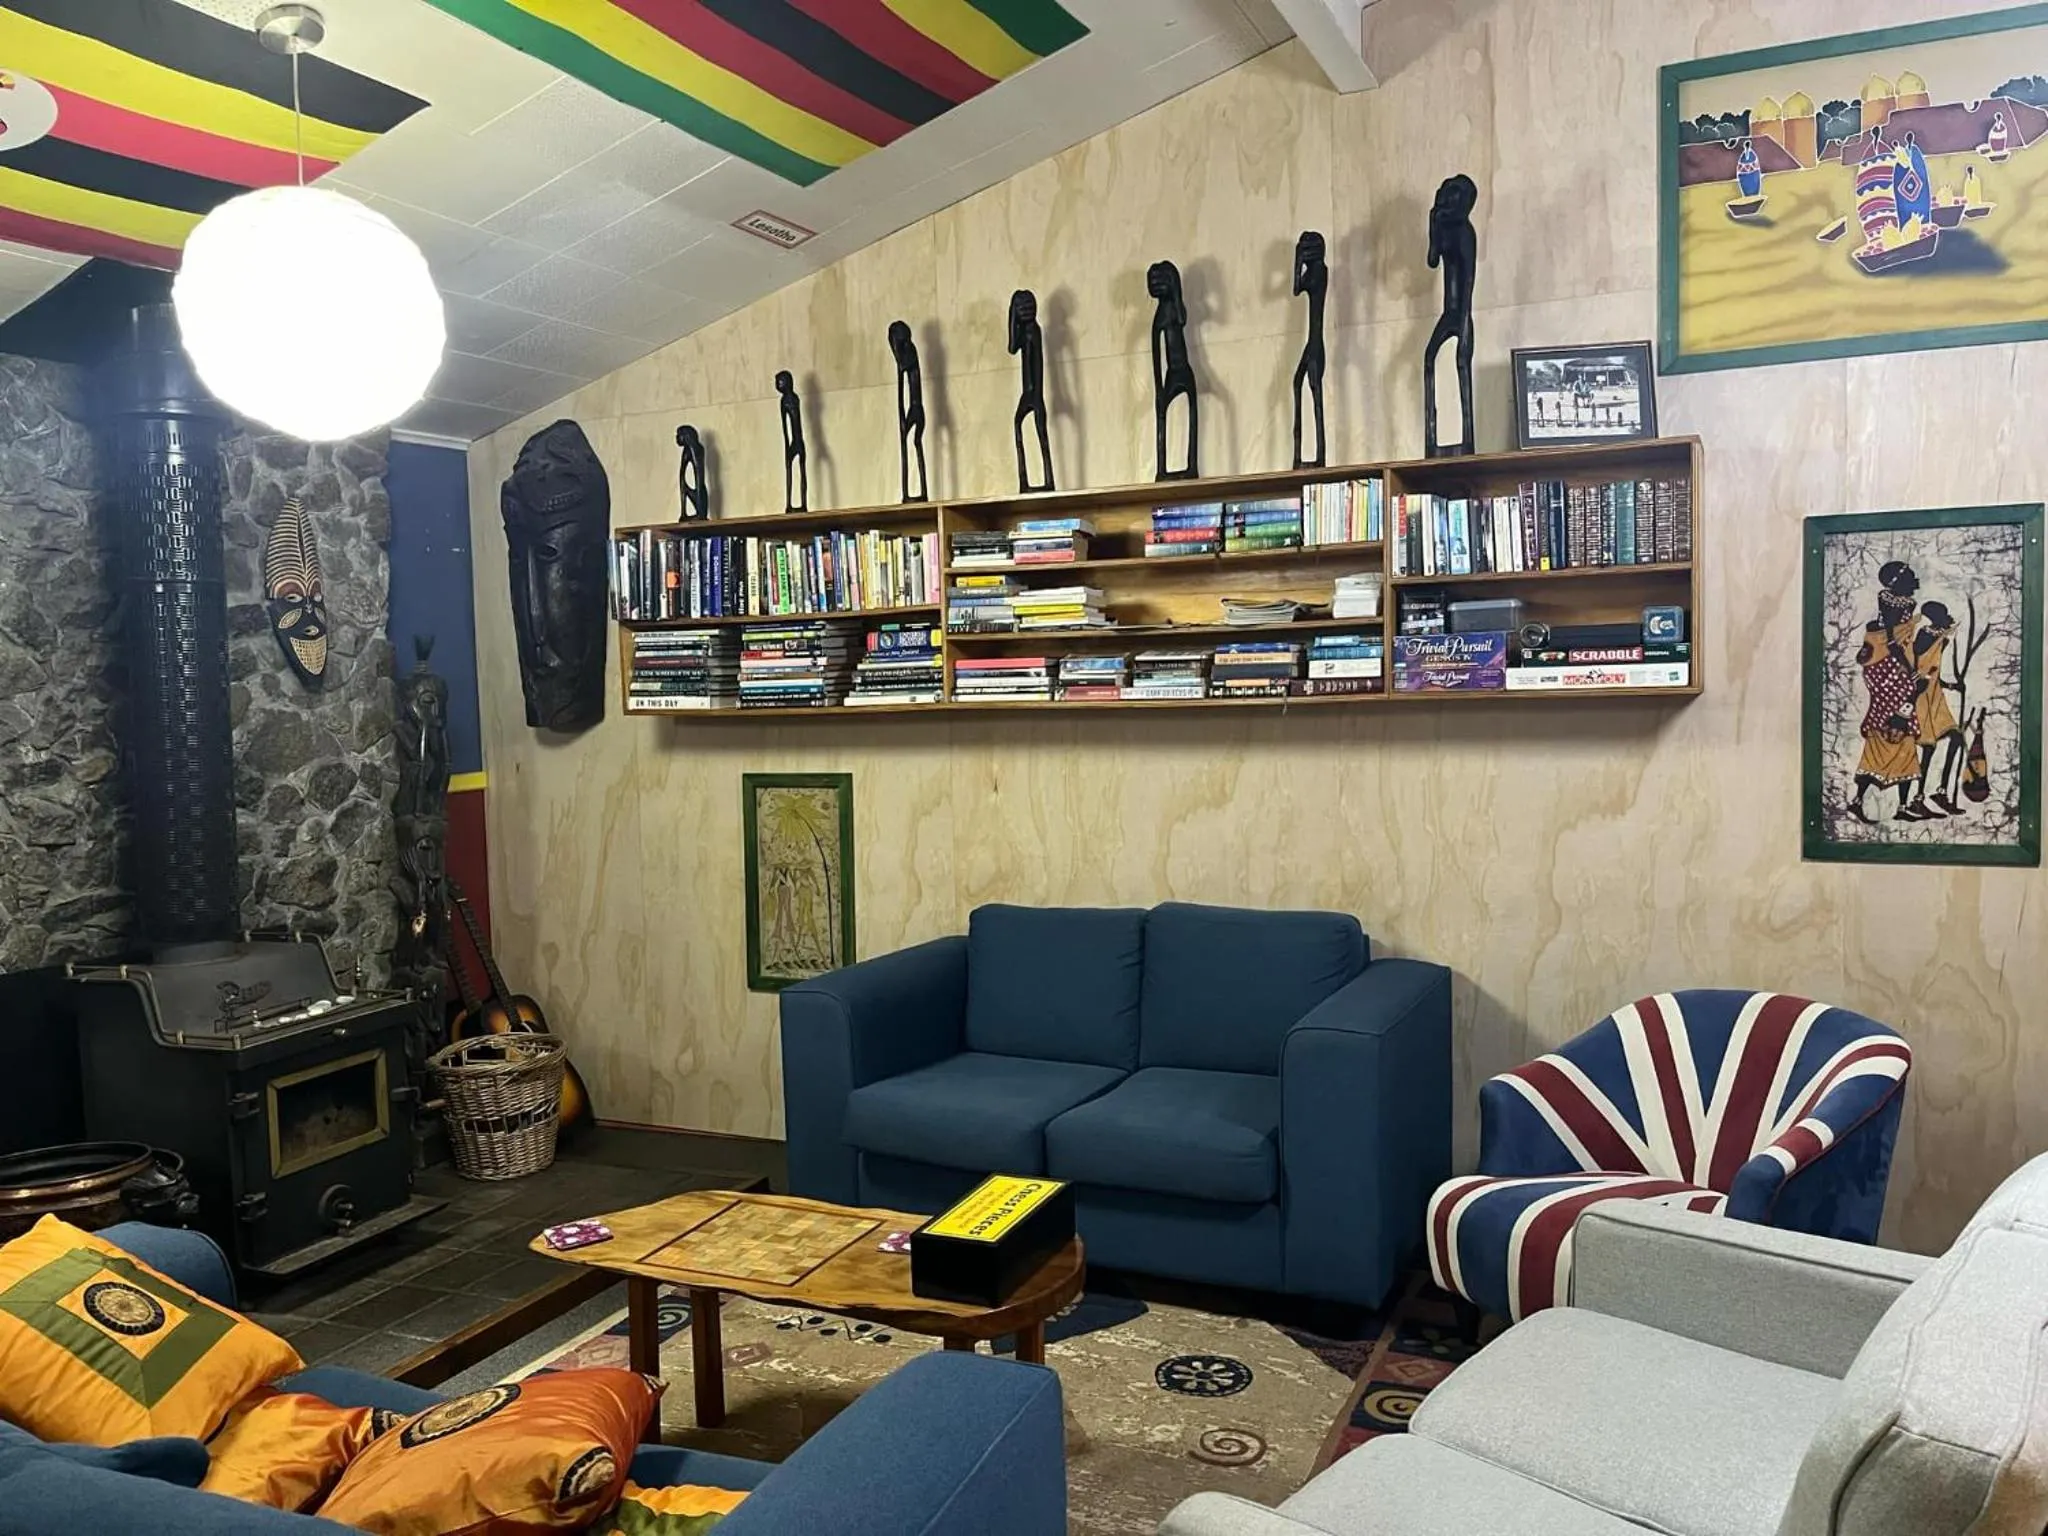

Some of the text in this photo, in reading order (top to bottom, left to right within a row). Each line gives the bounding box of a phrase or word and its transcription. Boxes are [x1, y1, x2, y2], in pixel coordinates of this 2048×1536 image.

[748, 218, 796, 241] Lesotho
[1406, 638, 1447, 656] Trivial
[1444, 635, 1493, 661] Pursuit
[1572, 648, 1642, 662] SCRABBLE
[664, 699, 679, 707] DAY
[1004, 1183, 1042, 1207] Chess
[968, 1207, 1014, 1236] Pieces
